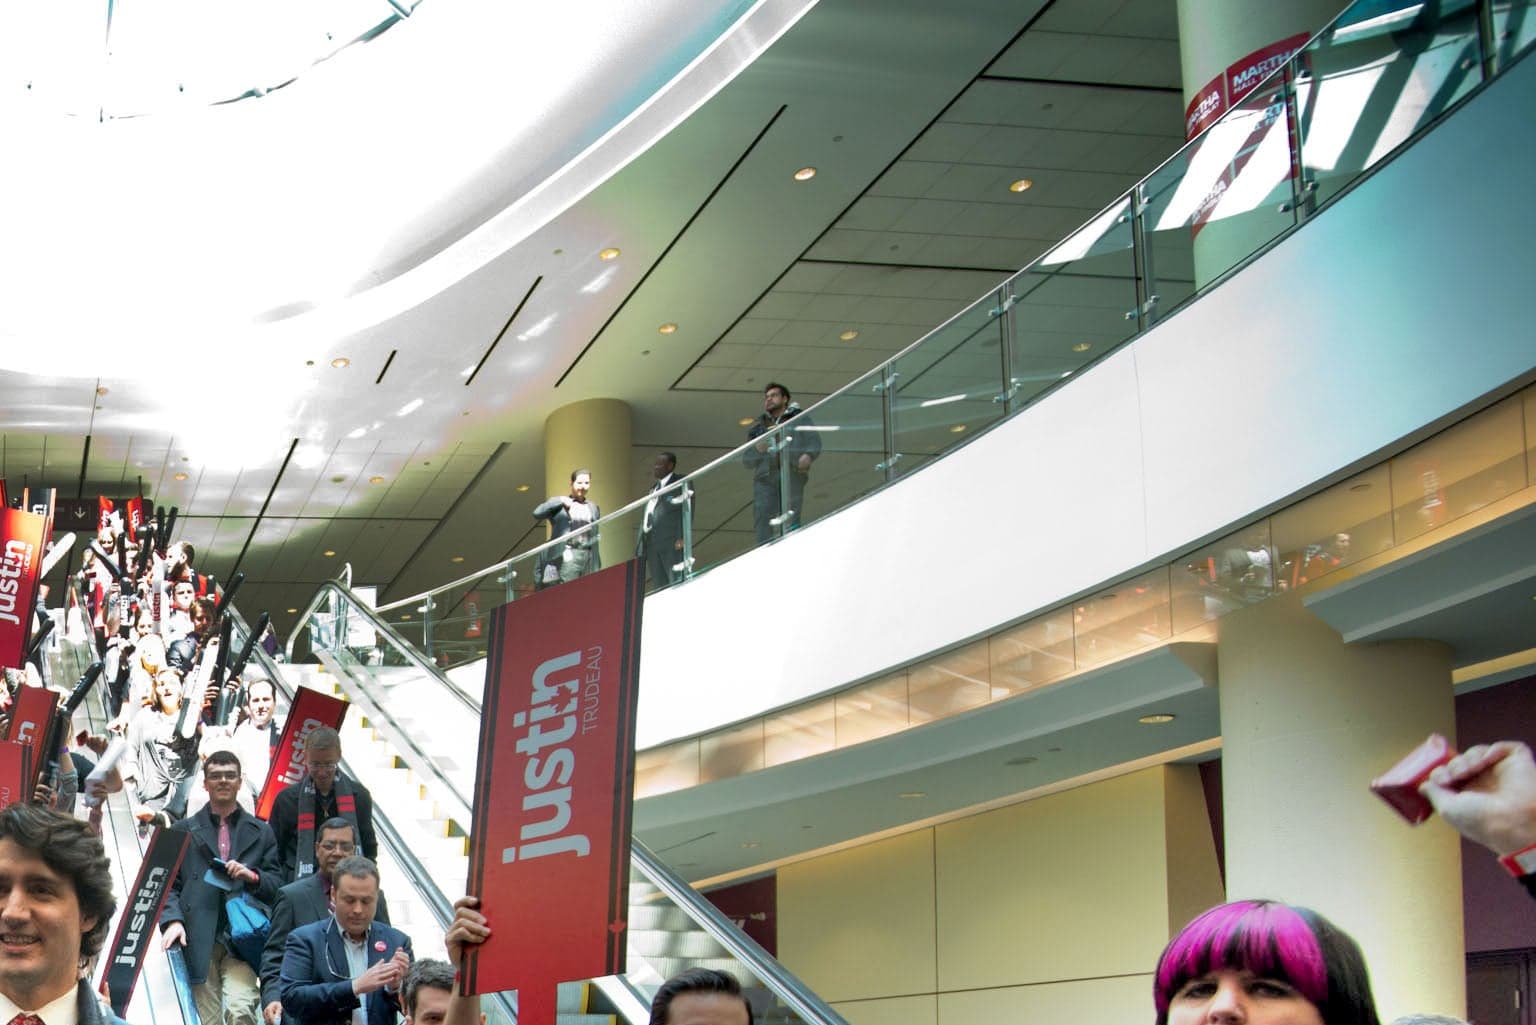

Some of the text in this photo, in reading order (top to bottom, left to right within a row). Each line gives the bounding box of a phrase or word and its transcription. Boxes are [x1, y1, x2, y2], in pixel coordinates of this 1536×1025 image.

[581, 645, 604, 736] TRUDEAU
[502, 649, 592, 864] justin
[115, 866, 166, 968] justin
